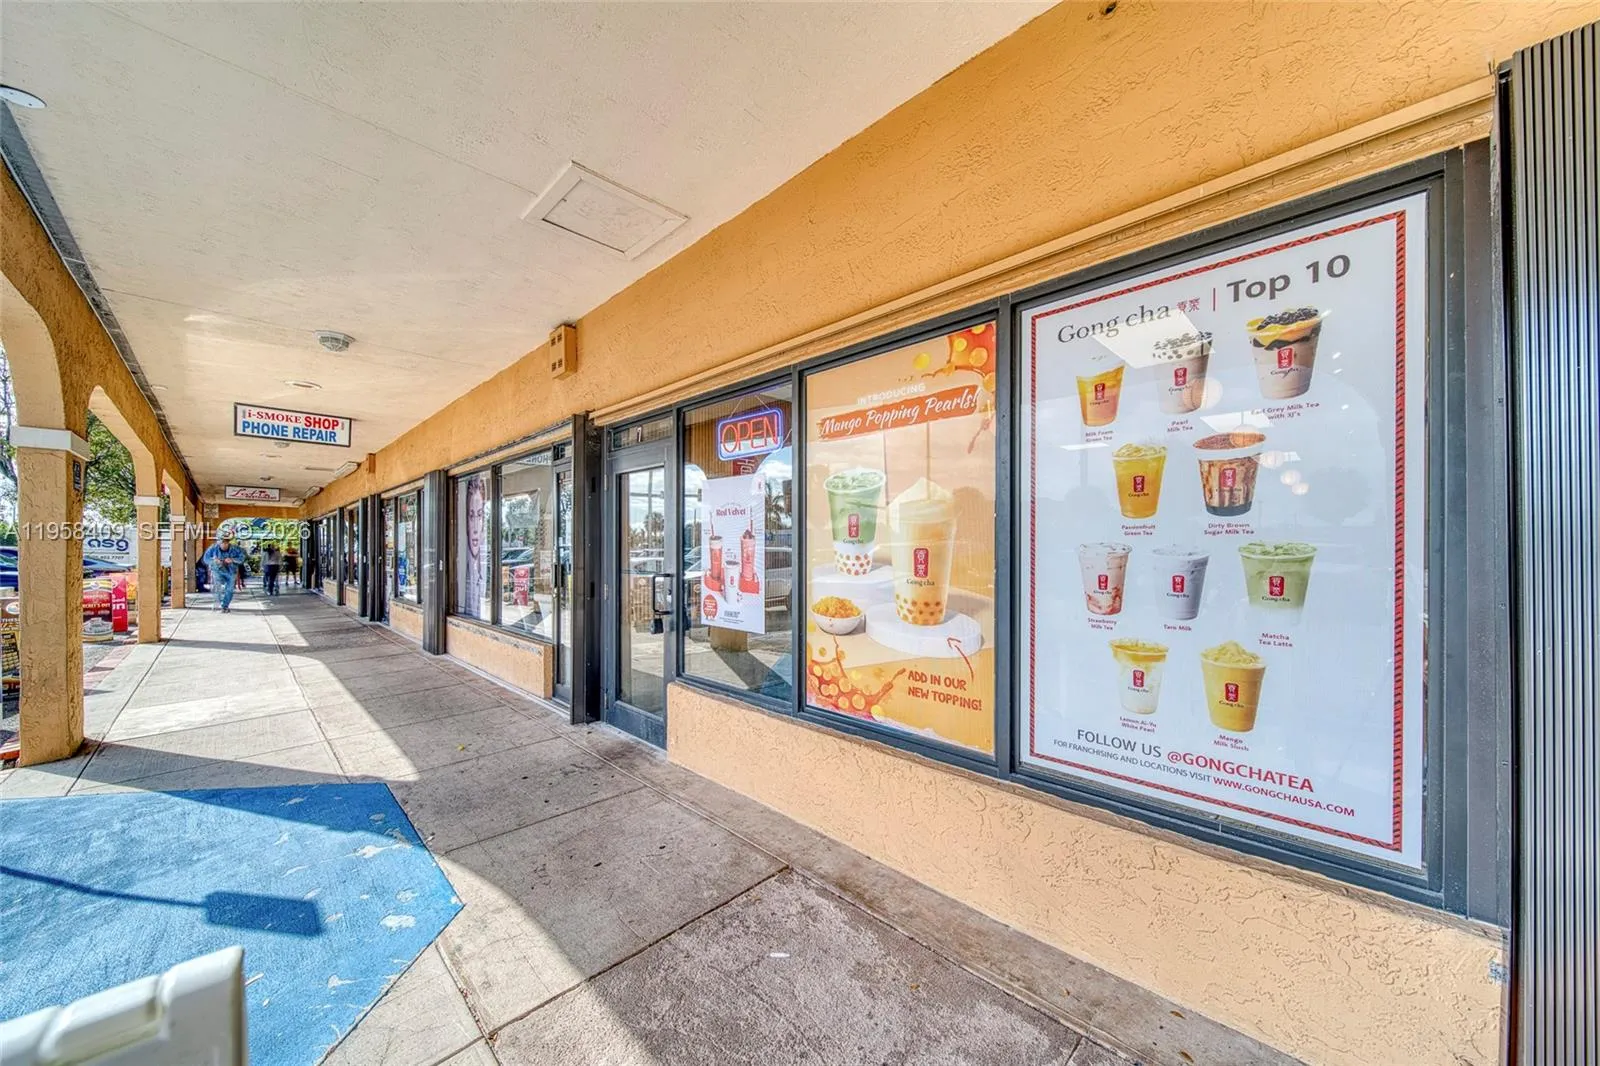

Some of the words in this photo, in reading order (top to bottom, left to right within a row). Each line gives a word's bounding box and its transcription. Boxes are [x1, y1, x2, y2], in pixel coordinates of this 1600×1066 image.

[1226, 274, 1291, 303] Top
[1305, 254, 1351, 284] 10
[1057, 315, 1120, 343] Gong
[1125, 304, 1171, 327] cha
[857, 382, 927, 406] INTRODUCING
[247, 409, 302, 424] i-SMOKE
[304, 415, 340, 431] SHOP
[820, 417, 862, 436] Mango
[866, 404, 921, 427] Popping
[924, 386, 982, 416] Pearls!
[1267, 405, 1285, 415] Grey
[1286, 404, 1304, 412] Milk
[242, 420, 289, 438] PHONE
[292, 426, 337, 443] REPAIR
[721, 413, 779, 454] OPEN
[1203, 529, 1223, 537] Sugar
[1224, 528, 1240, 536] Milk
[1241, 528, 1255, 536] Tea
[1207, 522, 1225, 531] Dirty
[1226, 522, 1250, 530] Brown
[906, 577, 924, 588] Gong
[924, 578, 936, 587] cha
[1087, 617, 1118, 626] Strawberry
[1178, 624, 1193, 632] Milk
[1261, 633, 1290, 641] Matcha
[1272, 640, 1294, 648] Latte
[907, 670, 928, 684] ADD
[930, 674, 942, 686] IN
[943, 676, 968, 692] OUR
[907, 686, 930, 699] NEW
[930, 690, 983, 711] TOPPING!
[1218, 734, 1244, 745] Mango
[1077, 728, 1137, 753] FOLLOW
[1141, 743, 1162, 759] US
[1167, 750, 1315, 793] @GONGCHATEA
[1053, 738, 1068, 749] FOR
[1068, 743, 1119, 761] FRANCHISING
[1119, 754, 1139, 766] AND
[1139, 759, 1189, 778] LOCATIONS
[1189, 771, 1211, 783] VISIT
[1212, 776, 1356, 817] WWW.GONGCHAUSA.COM
